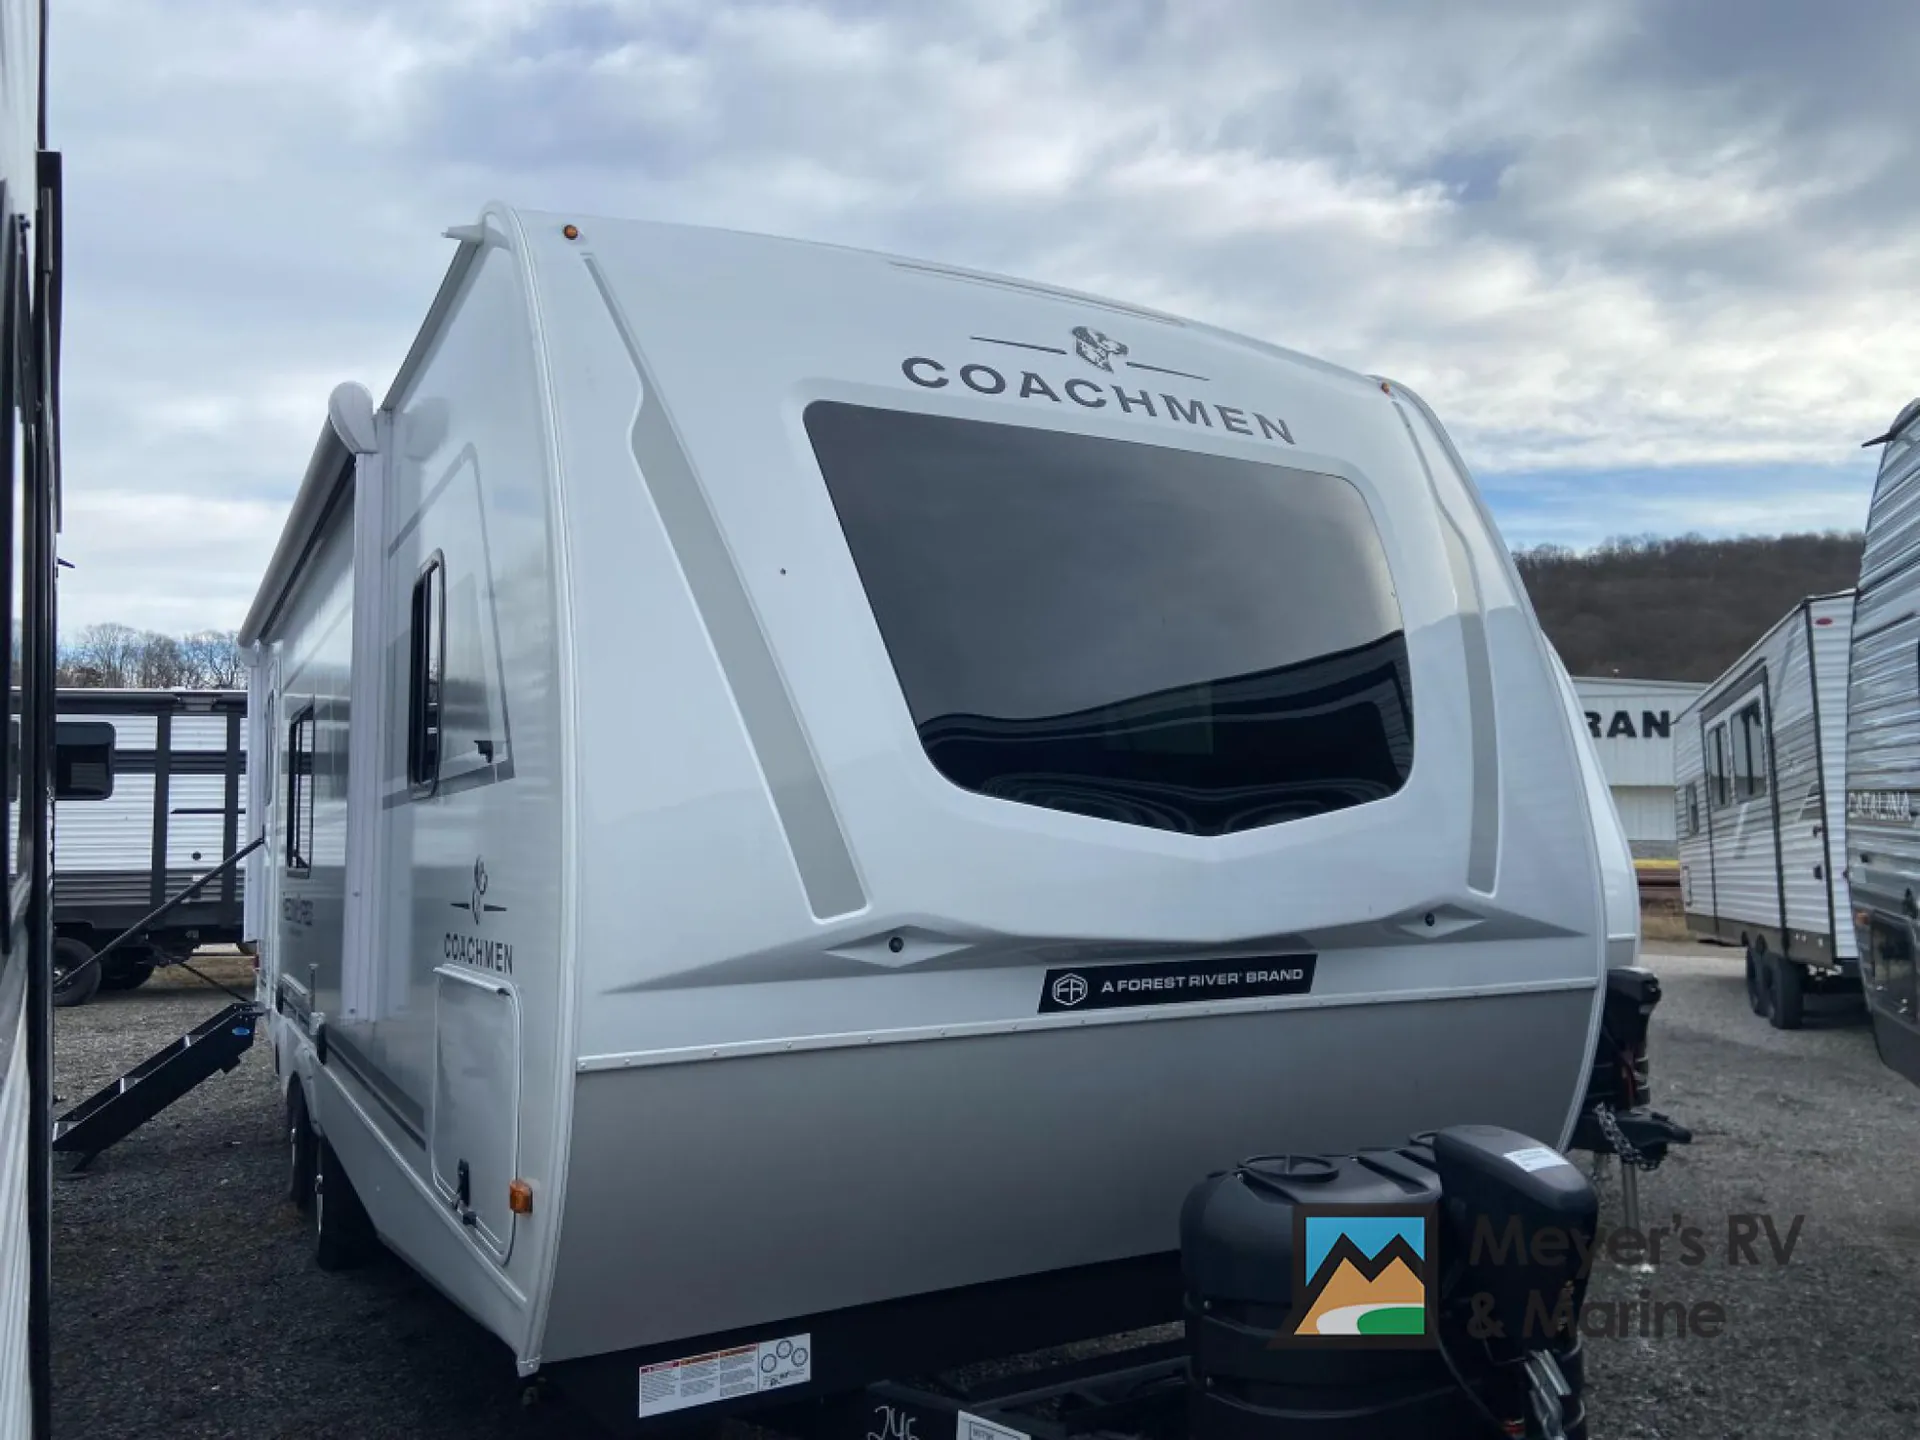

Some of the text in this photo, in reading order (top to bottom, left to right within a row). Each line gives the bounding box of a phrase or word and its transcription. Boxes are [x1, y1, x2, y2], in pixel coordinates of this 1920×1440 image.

[902, 356, 1295, 445] COACHMEN
[444, 932, 513, 977] COACHMEN
[1101, 980, 1115, 993] A
[1117, 976, 1186, 992] FOREST
[1246, 968, 1304, 984] BRAND
